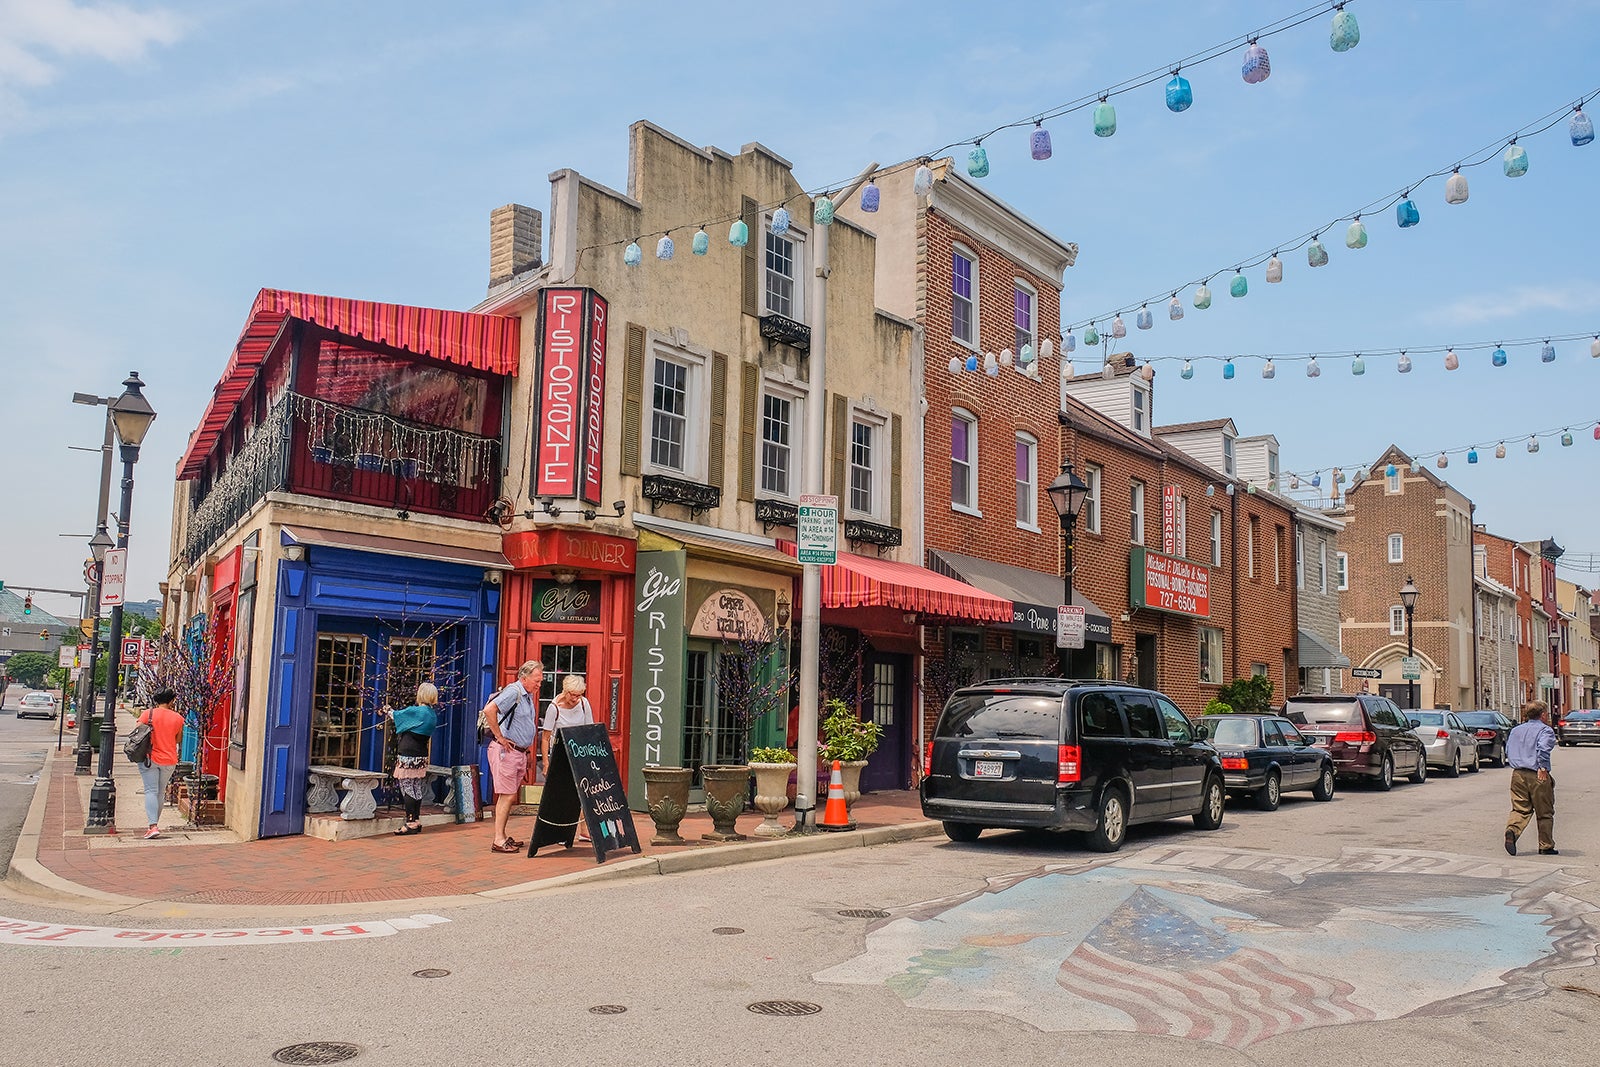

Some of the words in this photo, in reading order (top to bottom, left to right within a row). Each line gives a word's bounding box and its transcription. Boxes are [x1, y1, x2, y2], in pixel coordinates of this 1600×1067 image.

[544, 295, 577, 483] RISTORANTE
[586, 303, 605, 485] RISTORANTE
[802, 508, 808, 516] 3
[811, 509, 834, 518] HOUR
[1164, 487, 1174, 554] INSURANCE
[111, 555, 119, 565] NO
[566, 536, 630, 569] DINNER
[104, 574, 123, 585] STOPPING
[1147, 554, 1167, 572] Michael
[1191, 566, 1196, 580] &
[1196, 567, 1207, 583] Sons
[1059, 606, 1083, 615] PARKING
[1159, 591, 1197, 613] 727-6504
[1027, 608, 1050, 631] Pane
[645, 611, 668, 768] RISTORAN
[590, 760, 601, 770] a
[113, 925, 372, 942] Piccola
